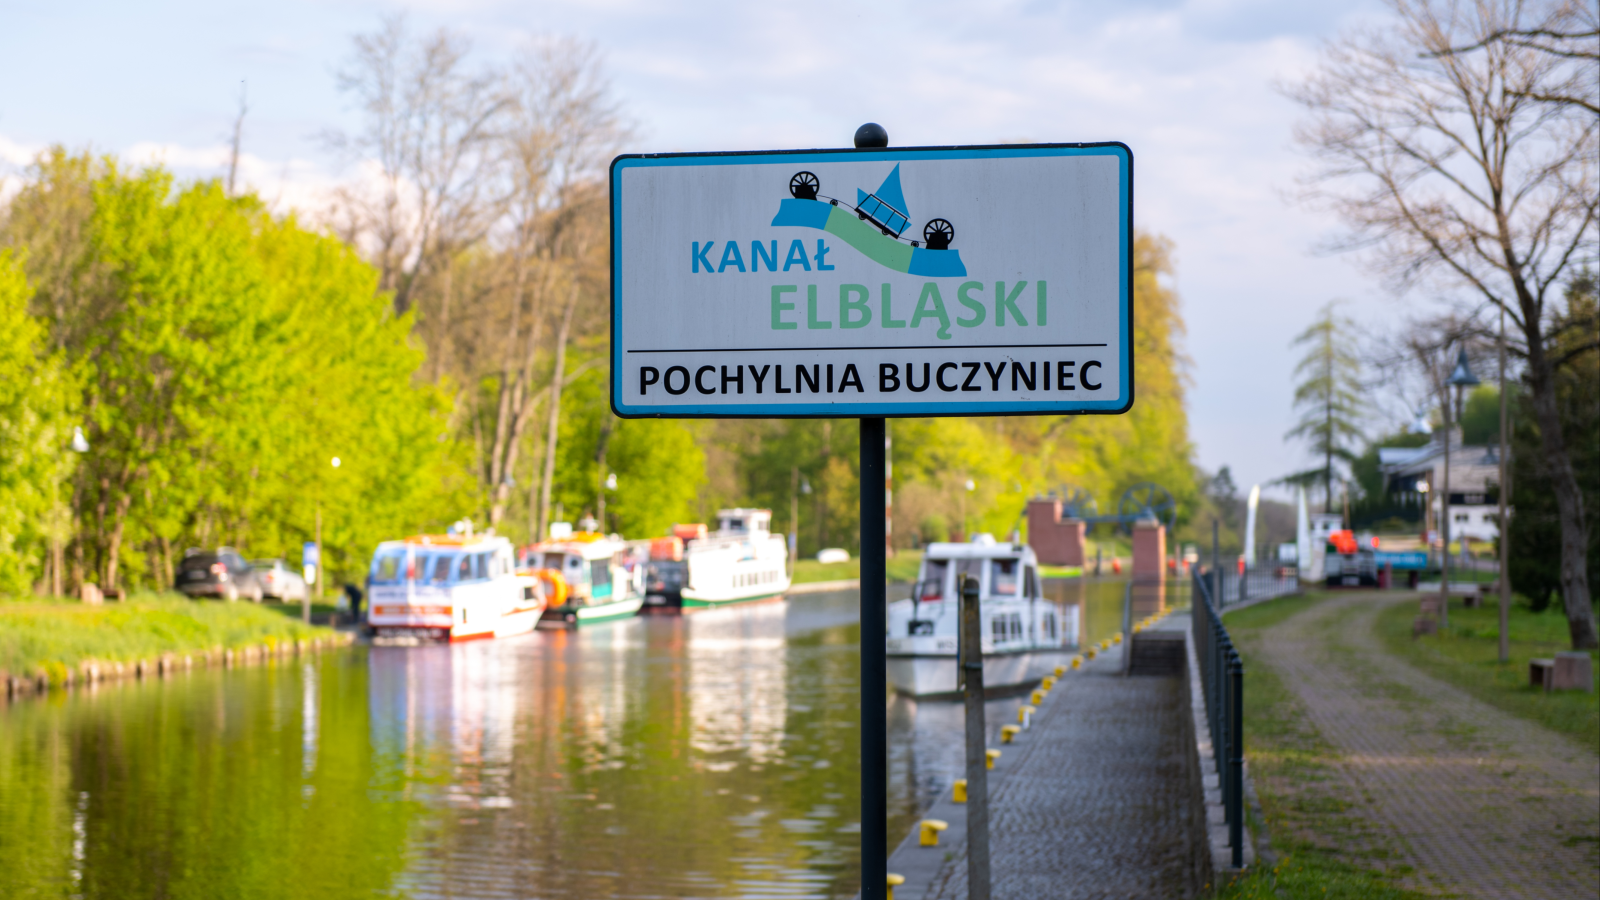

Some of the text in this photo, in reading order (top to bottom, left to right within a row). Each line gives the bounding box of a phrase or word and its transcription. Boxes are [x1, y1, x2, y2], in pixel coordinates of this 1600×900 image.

[691, 239, 836, 274] KANAŁ
[770, 280, 1048, 340] ELBLĄSKI
[639, 359, 1103, 396] POCHYLNIA BUCZYNIEC
